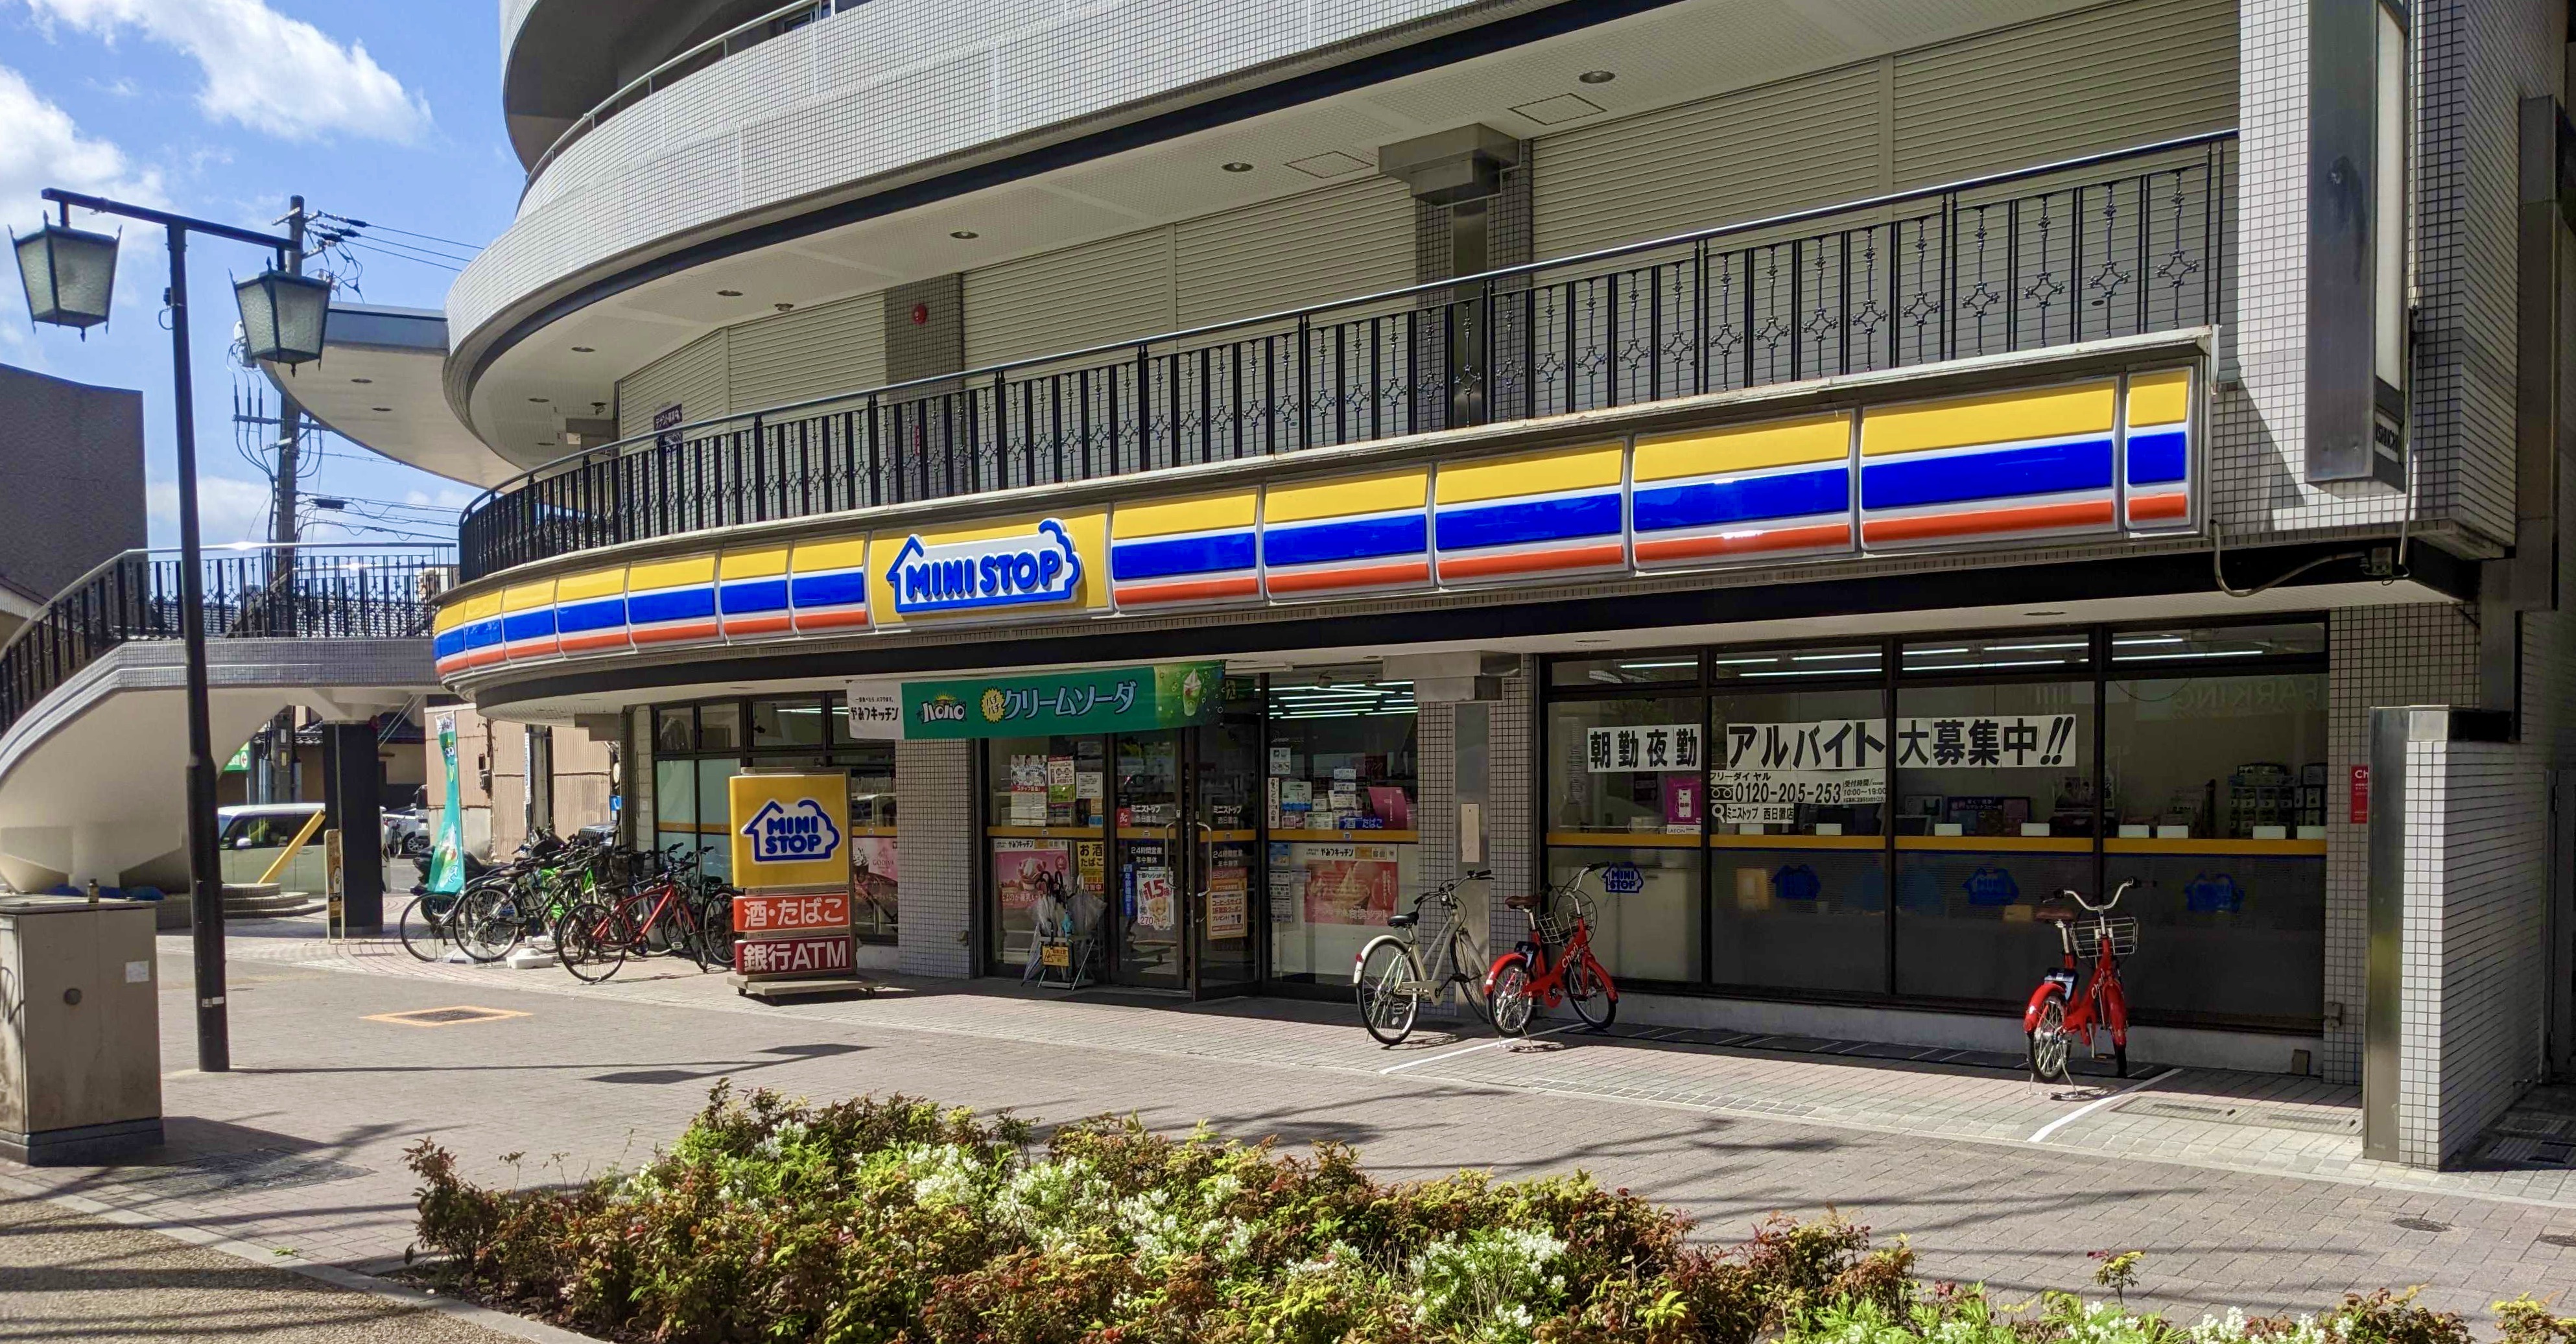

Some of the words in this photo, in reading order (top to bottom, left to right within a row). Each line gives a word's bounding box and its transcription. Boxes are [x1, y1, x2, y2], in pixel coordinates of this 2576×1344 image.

[906, 558, 975, 599] MINI
[980, 550, 1061, 593] STOP
[1003, 681, 1137, 719] クリームソーダ
[1590, 728, 1697, 768] 朝勤夜勤
[1728, 721, 1885, 769] アルバイト
[1736, 783, 1841, 803] 0120-205-253
[1131, 805, 1161, 813] ミニストップ
[1213, 805, 1242, 814] ミニストップ
[1727, 807, 1758, 819] ミニストップ
[766, 815, 819, 835] MINI
[765, 834, 822, 853] STOP
[1080, 844, 1103, 856] お酒
[1611, 871, 1634, 880] MINI
[1611, 880, 1635, 890] STOP
[744, 897, 844, 928] 酒・たばこ
[743, 940, 847, 972] 銀行ATM
